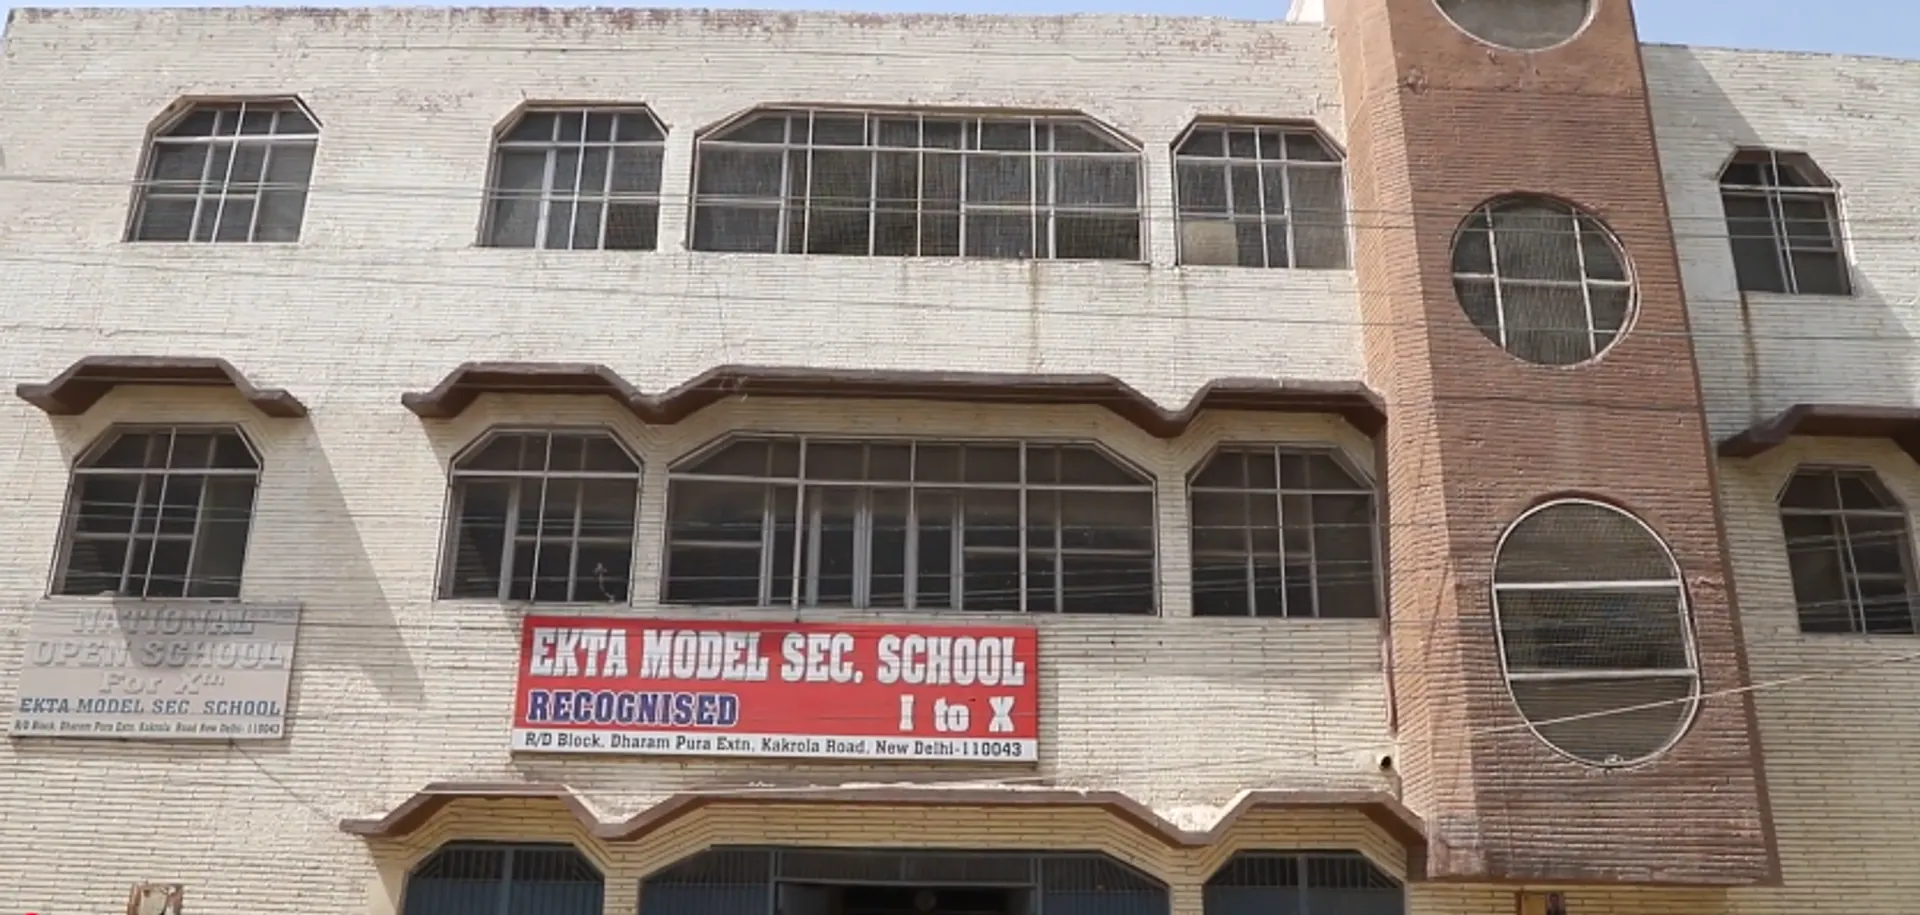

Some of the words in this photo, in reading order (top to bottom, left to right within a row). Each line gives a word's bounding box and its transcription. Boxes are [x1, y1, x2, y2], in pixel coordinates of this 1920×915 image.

[74, 606, 254, 636] NATIONAL
[33, 640, 132, 668] OPEN
[142, 642, 285, 668] SCHOOL
[529, 627, 628, 676] EKTA
[641, 629, 769, 682] MODEL
[781, 632, 864, 683] SEC.
[878, 634, 1026, 686] SCHOOL
[99, 673, 164, 694] For
[20, 698, 69, 714] EKTA
[76, 698, 144, 714] MODEL
[204, 700, 280, 716] SCHOOL
[527, 689, 739, 726] RECOGNISED
[899, 695, 915, 731] I
[934, 697, 969, 732] to
[989, 696, 1015, 732] X
[93, 721, 114, 732] Pura
[138, 722, 171, 732] Kakrola
[176, 722, 197, 732] Road
[200, 723, 217, 733] New
[525, 731, 552, 747] R/D
[611, 734, 670, 750] Dharam
[675, 735, 711, 750] Pura
[761, 737, 820, 753] Kakrola
[876, 740, 908, 756] New
[913, 740, 1022, 757] Delhi-110043
